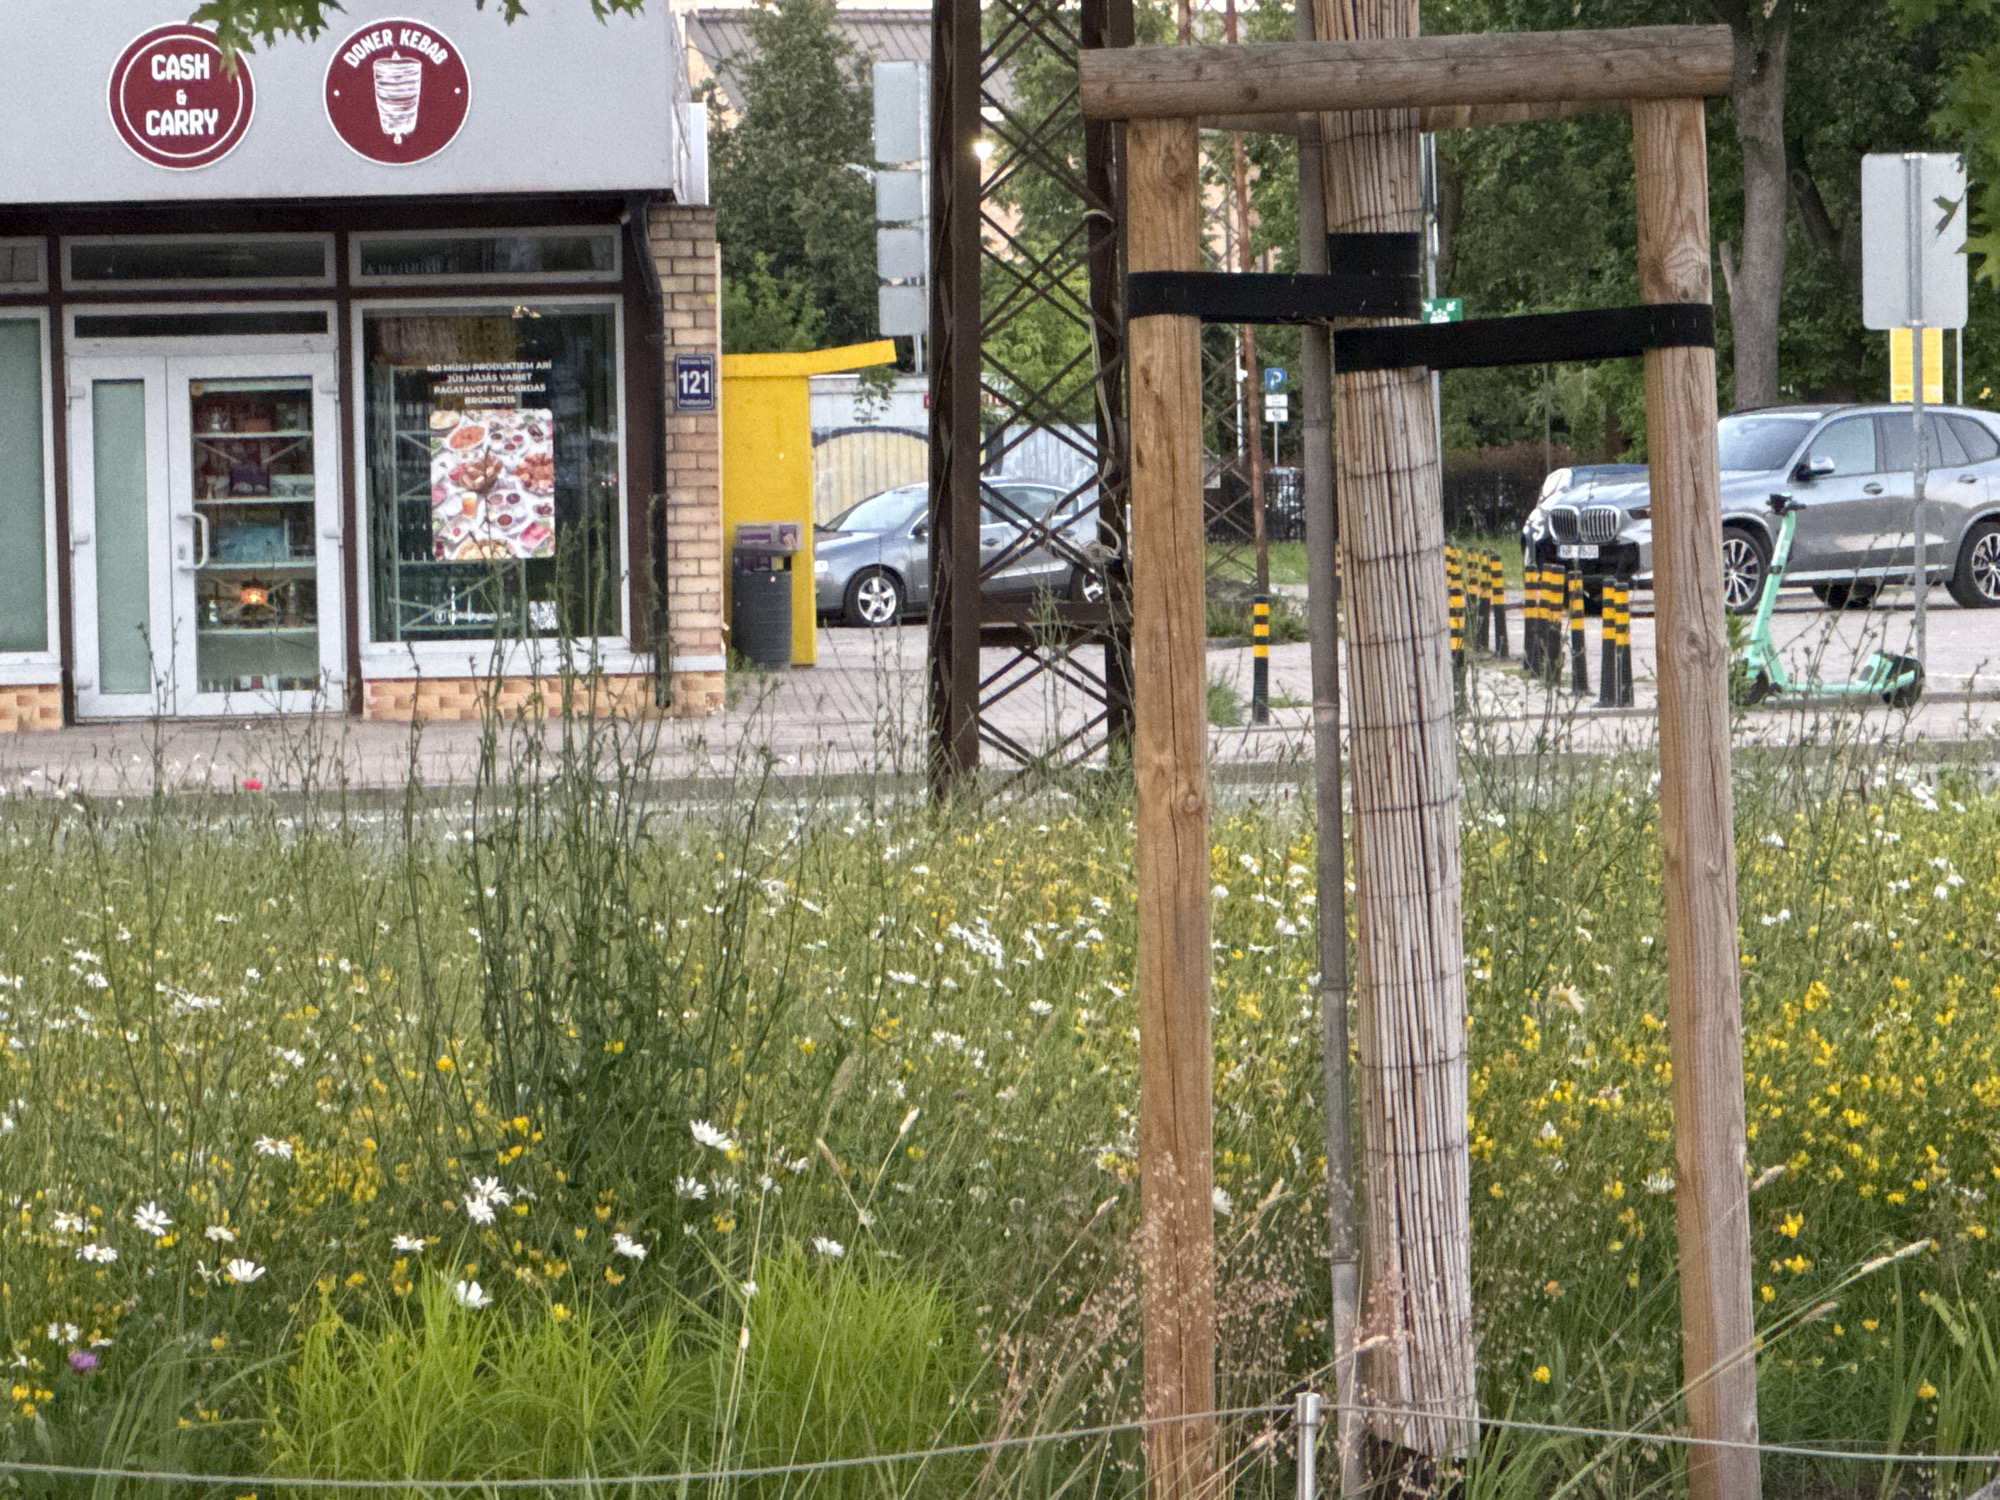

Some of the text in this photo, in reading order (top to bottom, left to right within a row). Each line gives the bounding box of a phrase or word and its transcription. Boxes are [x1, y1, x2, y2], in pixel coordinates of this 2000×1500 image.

[343, 28, 449, 68] DONER KEBAB
[151, 53, 210, 80] CASH
[175, 88, 187, 105] &
[145, 108, 219, 136] CARRY
[473, 361, 534, 371] PRODUKTIEM
[679, 370, 710, 394] 121
